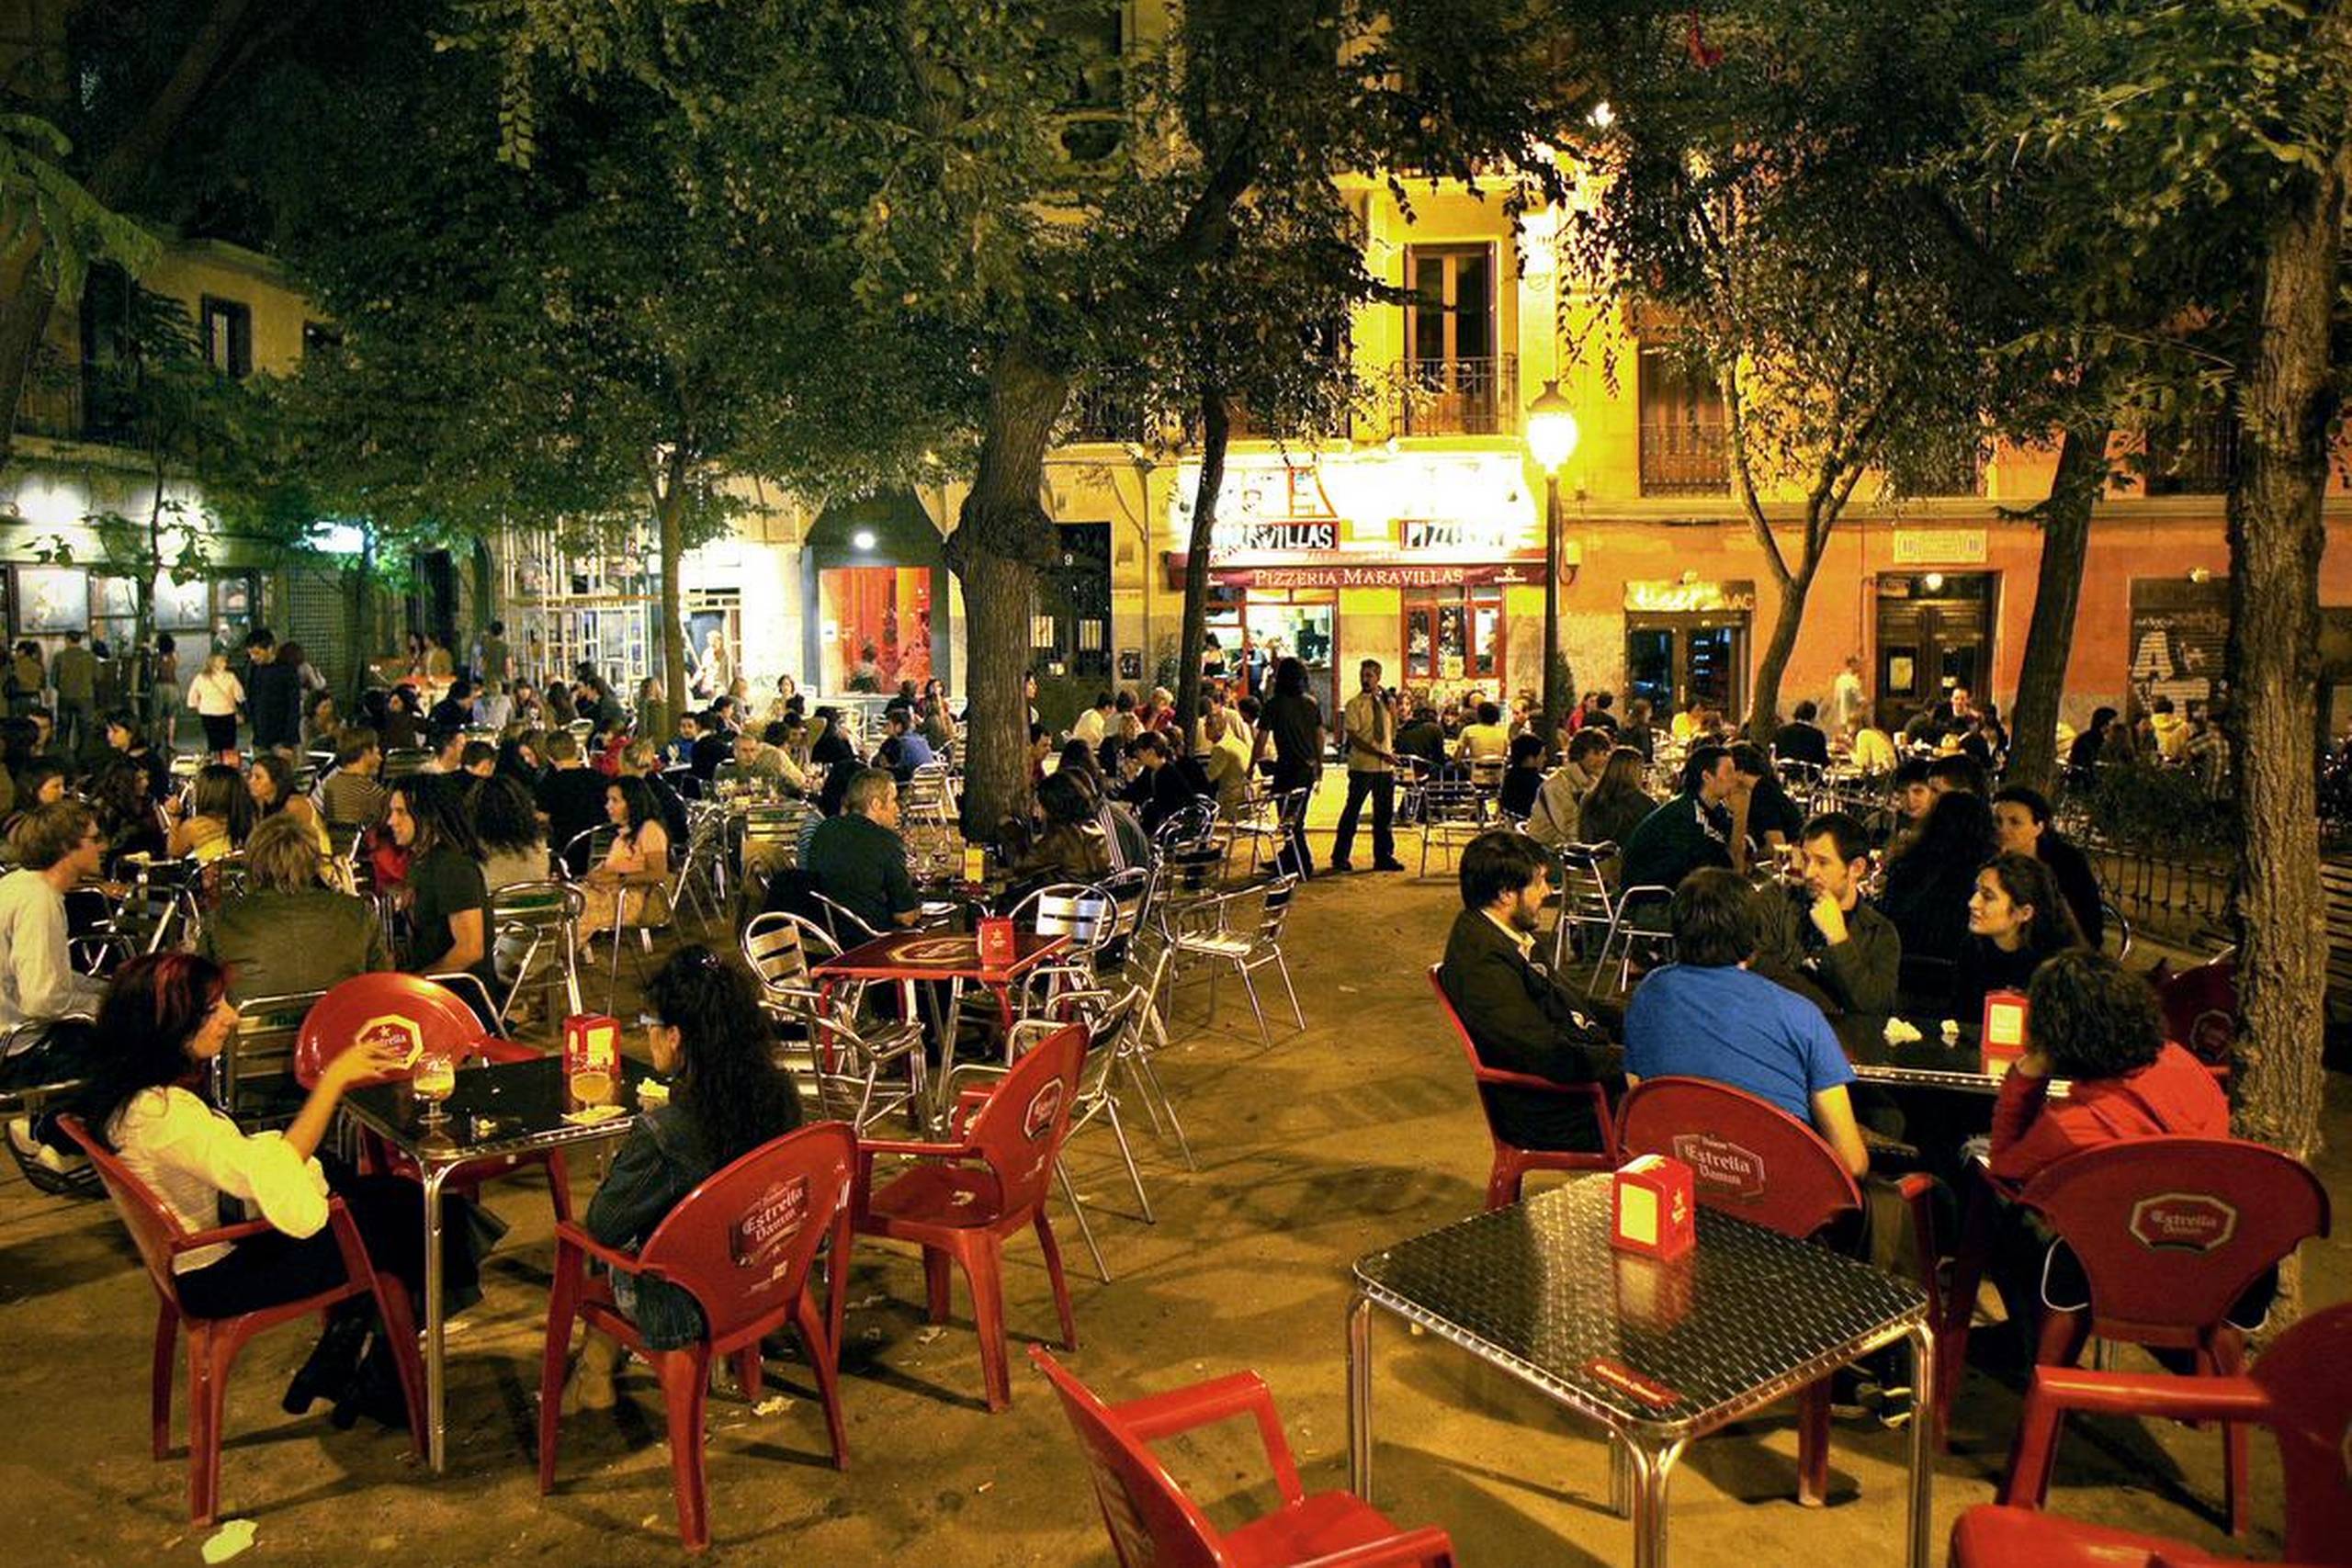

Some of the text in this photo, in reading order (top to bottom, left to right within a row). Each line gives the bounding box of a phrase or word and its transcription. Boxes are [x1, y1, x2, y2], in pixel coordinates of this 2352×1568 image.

[1064, 553, 1073, 566] 9
[1254, 568, 1464, 585] PIZZERIA MARAVILLAS
[1683, 1144, 1751, 1175] Estrella
[741, 1187, 804, 1235] Estrella
